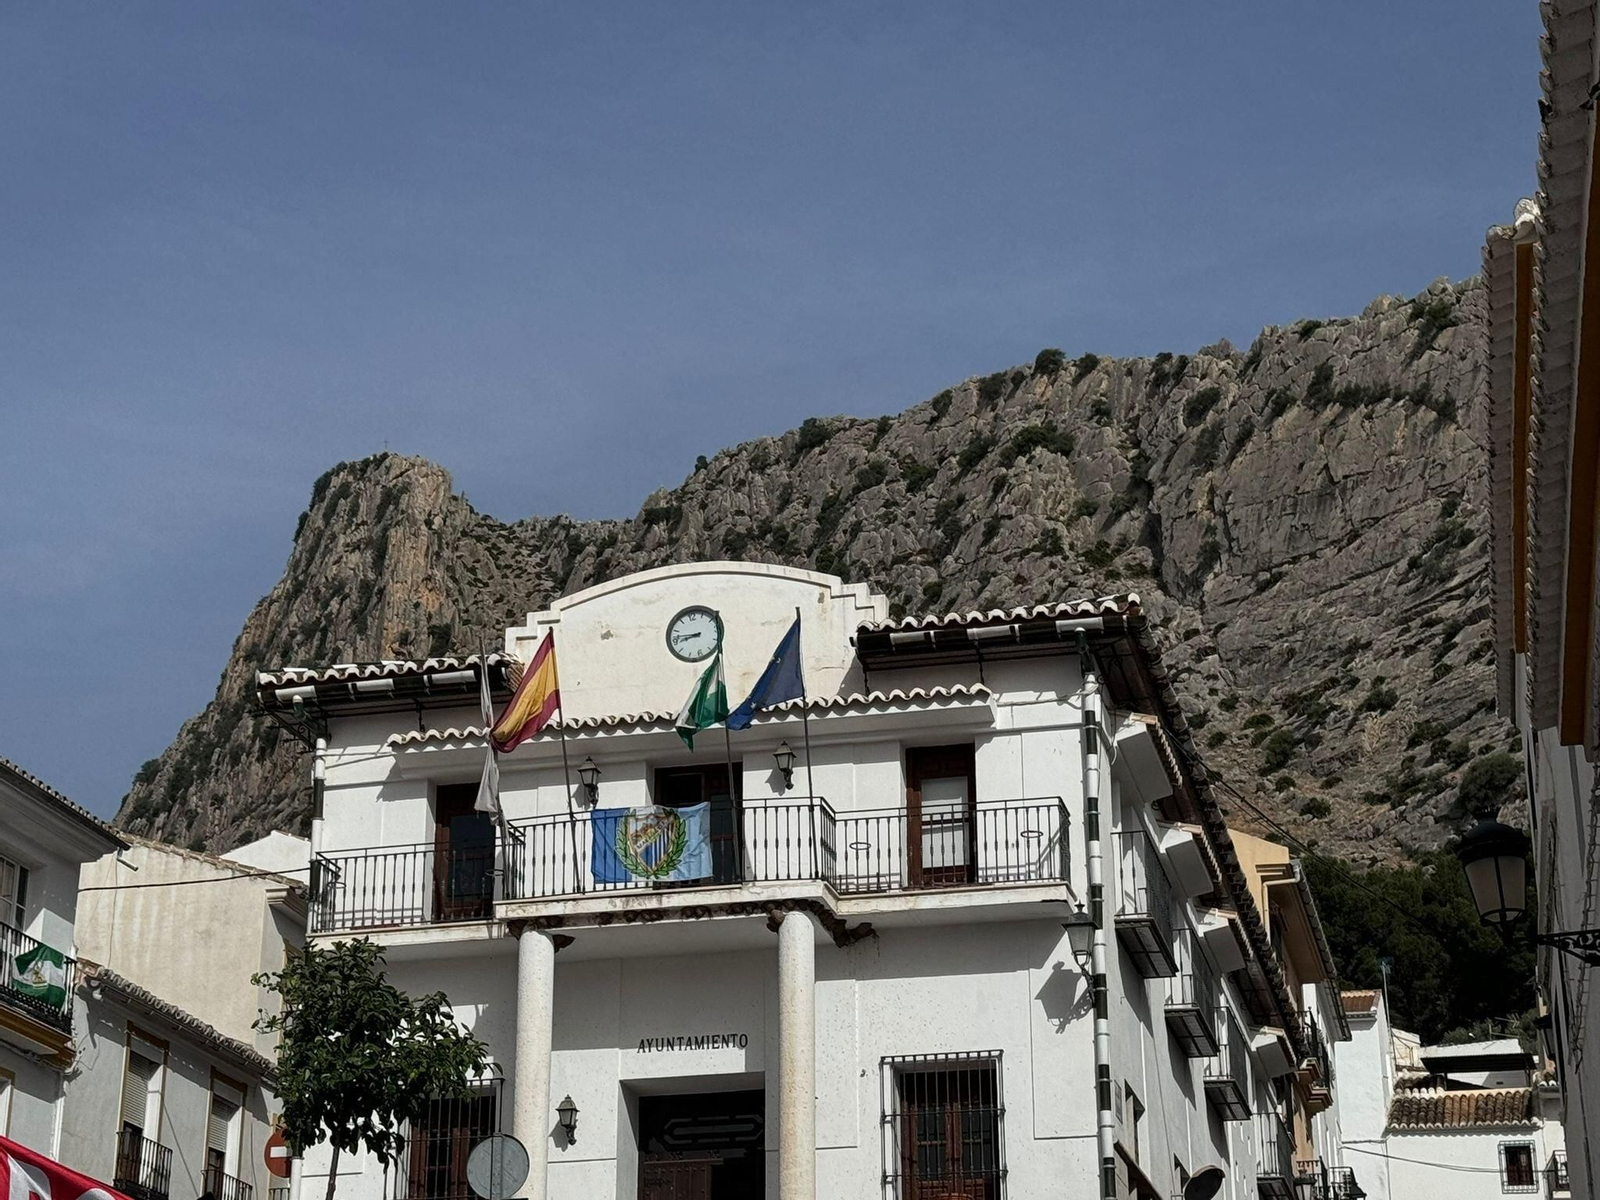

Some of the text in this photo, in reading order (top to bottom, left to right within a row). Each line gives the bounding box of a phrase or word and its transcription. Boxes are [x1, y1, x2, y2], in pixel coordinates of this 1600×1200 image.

[688, 612, 697, 622] 12
[672, 637, 679, 646] 9
[697, 649, 704, 657] 6
[637, 1033, 749, 1053] AYUNTAMIENTO
